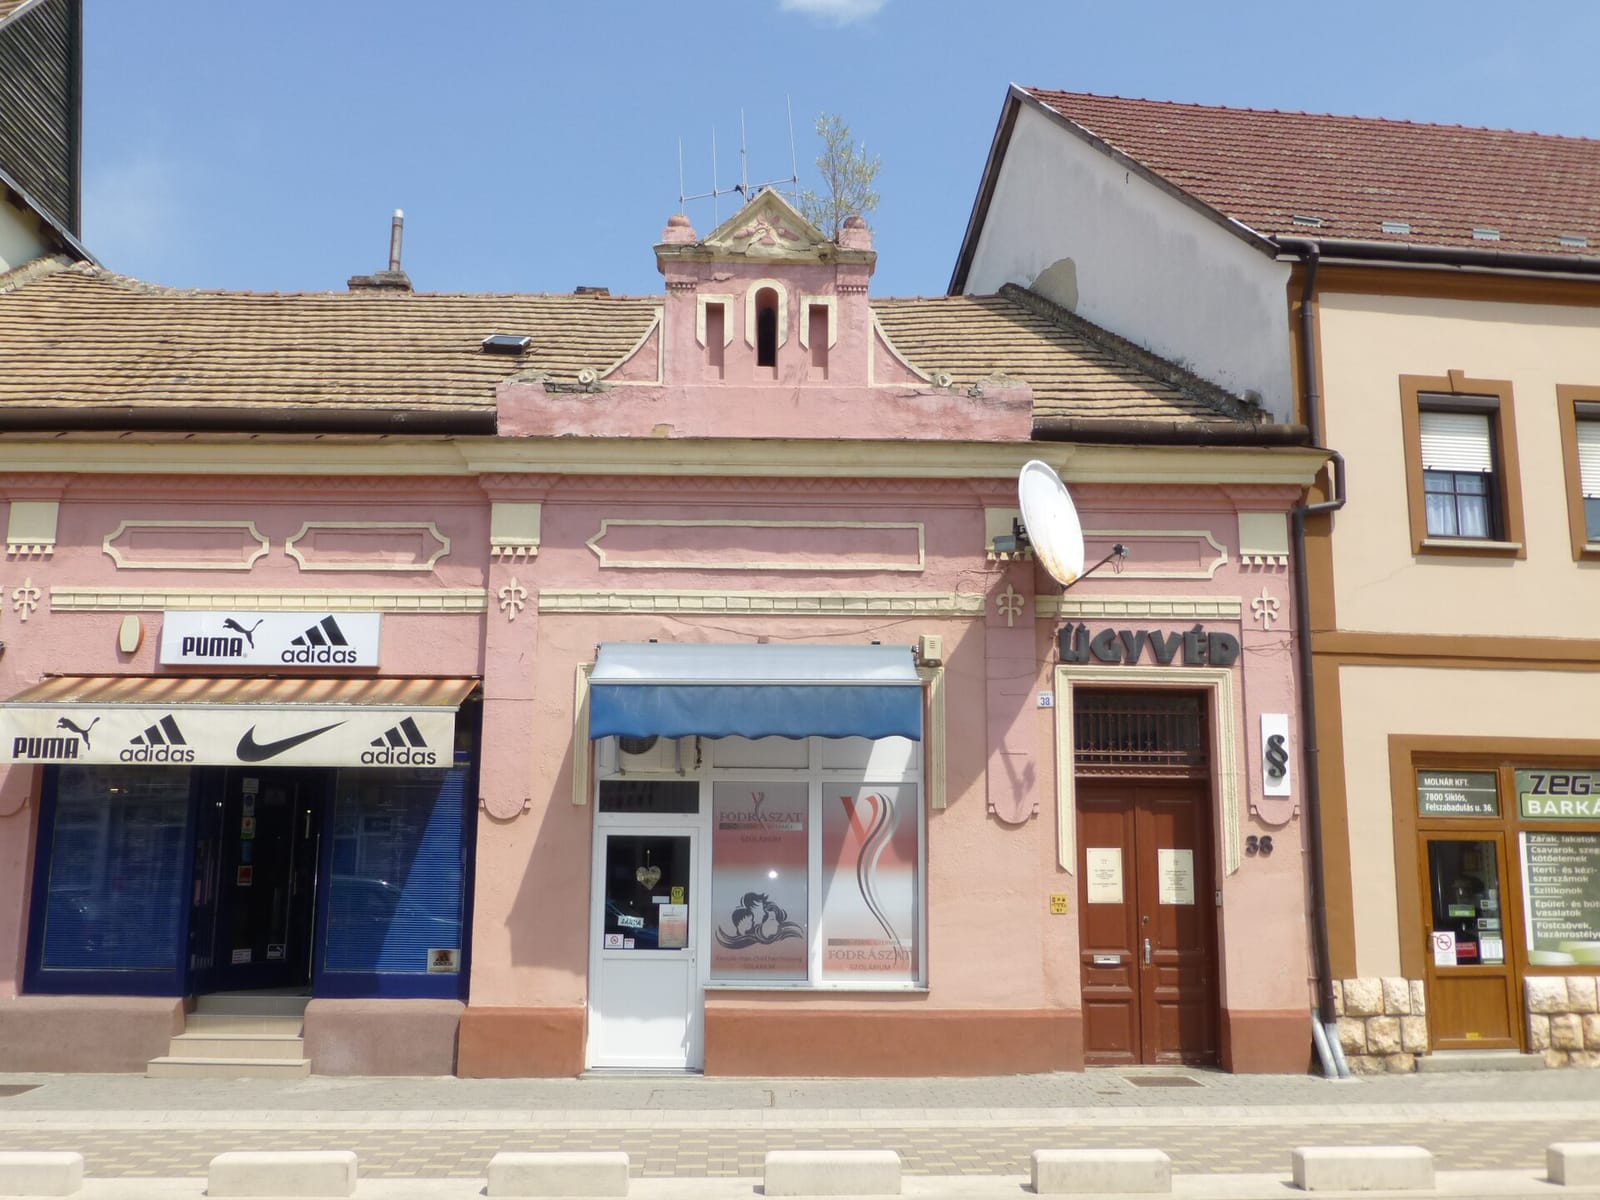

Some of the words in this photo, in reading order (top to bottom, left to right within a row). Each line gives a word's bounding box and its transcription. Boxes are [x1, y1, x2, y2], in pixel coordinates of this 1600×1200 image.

[182, 637, 243, 657] PUMA
[1058, 622, 1240, 665] ÜGYVÉD
[281, 646, 357, 664] adidas
[1040, 697, 1050, 705] 38
[13, 737, 79, 759] PUMA
[119, 744, 195, 763] adidas
[360, 746, 437, 765] adidas
[1424, 777, 1454, 786] MOLNÁR
[1455, 778, 1469, 787] KFT.
[1425, 793, 1443, 801] 7800
[1425, 803, 1474, 812] Felszabadulás
[1245, 835, 1273, 856] 38
[1562, 866, 1572, 874] és
[1571, 900, 1582, 908] és
